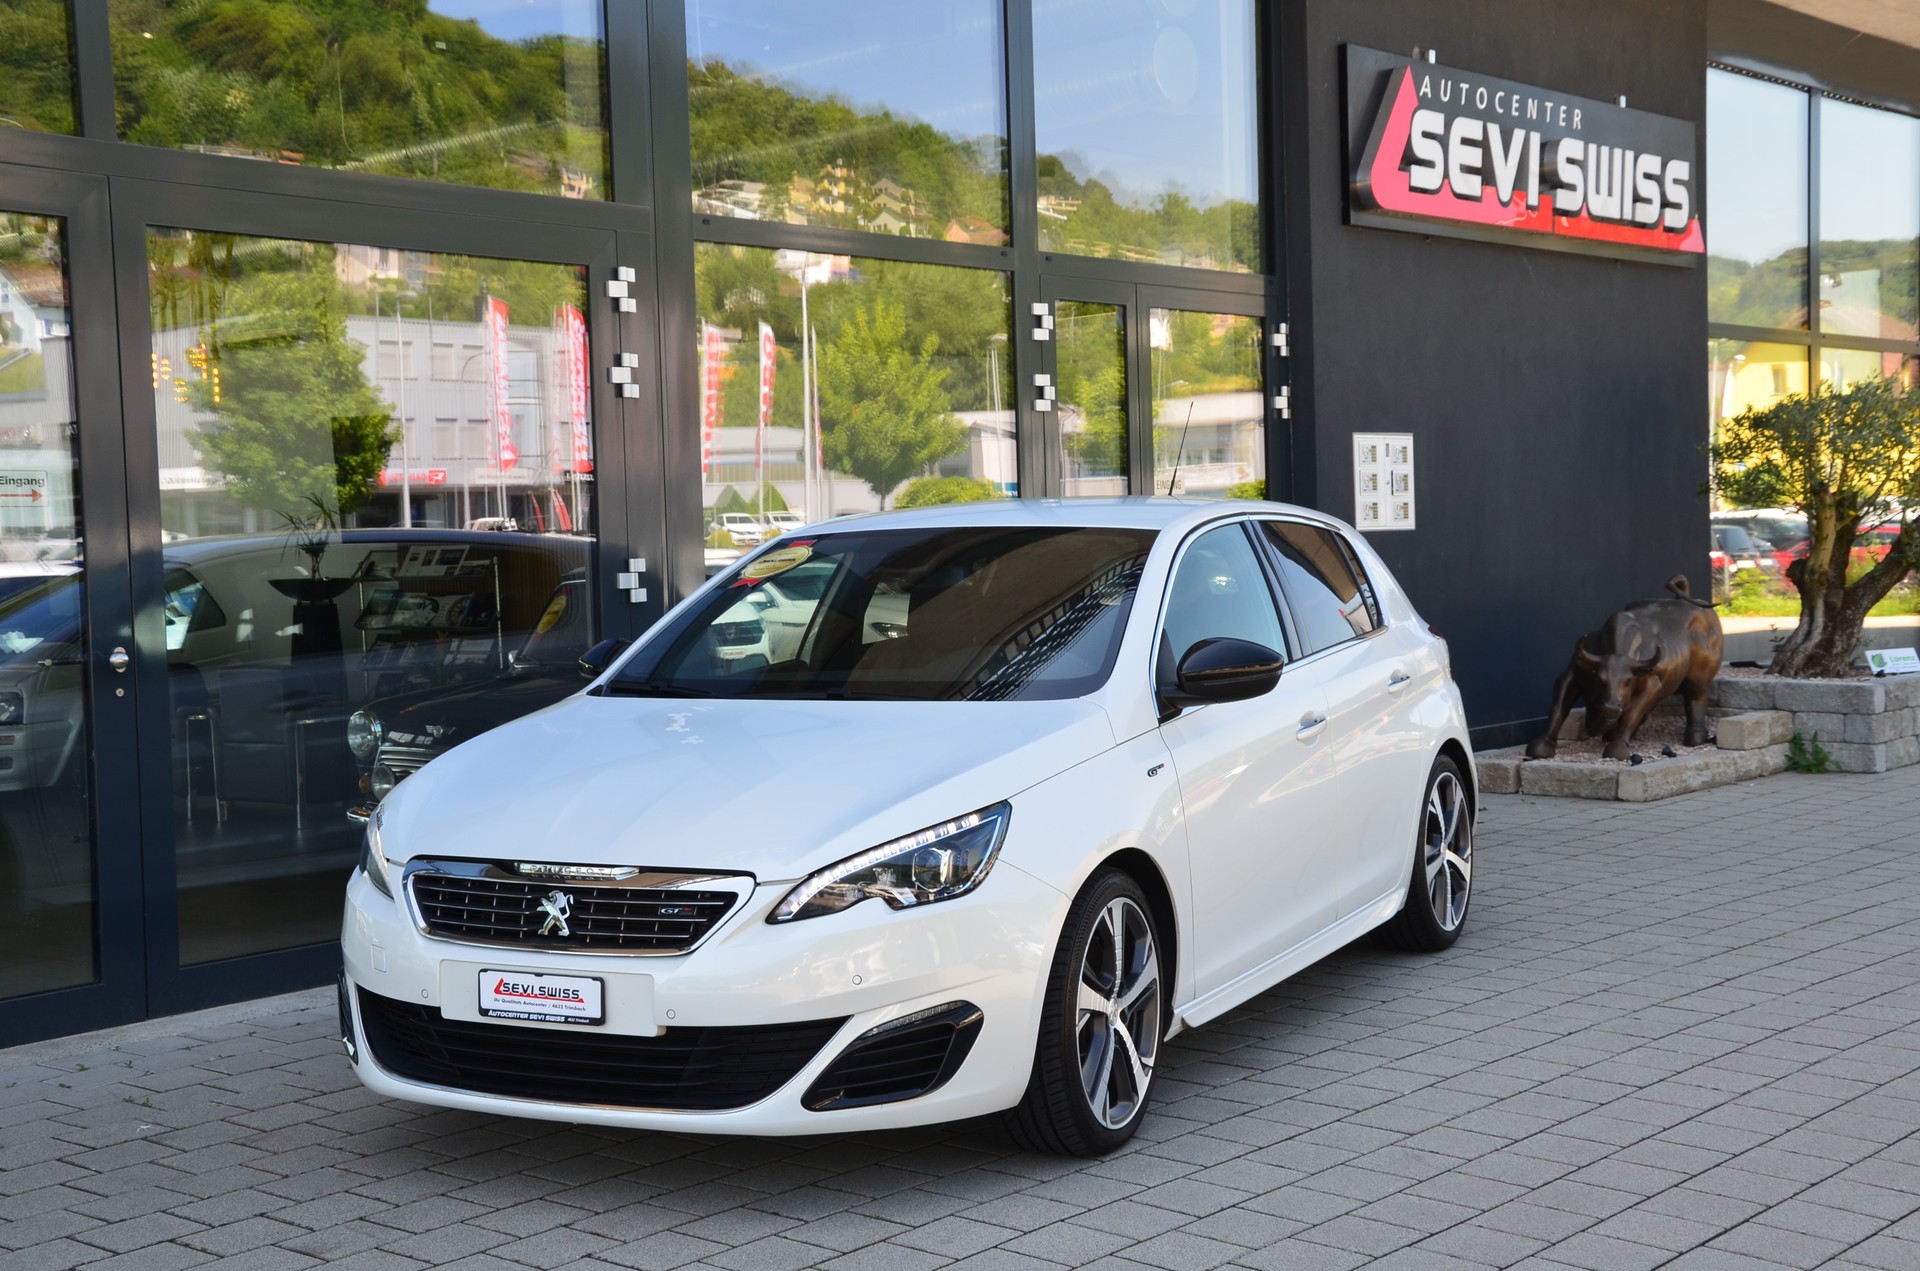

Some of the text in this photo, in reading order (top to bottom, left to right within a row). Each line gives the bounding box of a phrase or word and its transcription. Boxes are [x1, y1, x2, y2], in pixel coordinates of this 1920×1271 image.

[1419, 75, 1582, 130] AUTOCENTER
[1409, 108, 1690, 230] SEVI SWISS
[0, 476, 45, 487] Eingang
[1156, 479, 1182, 489] EINGNG
[530, 864, 606, 877] PEUGEOT
[660, 907, 683, 915] GT
[502, 982, 580, 1000] SEVI SWISS
[523, 1000, 548, 1008] Autocenter
[545, 1015, 566, 1023] SWISS
